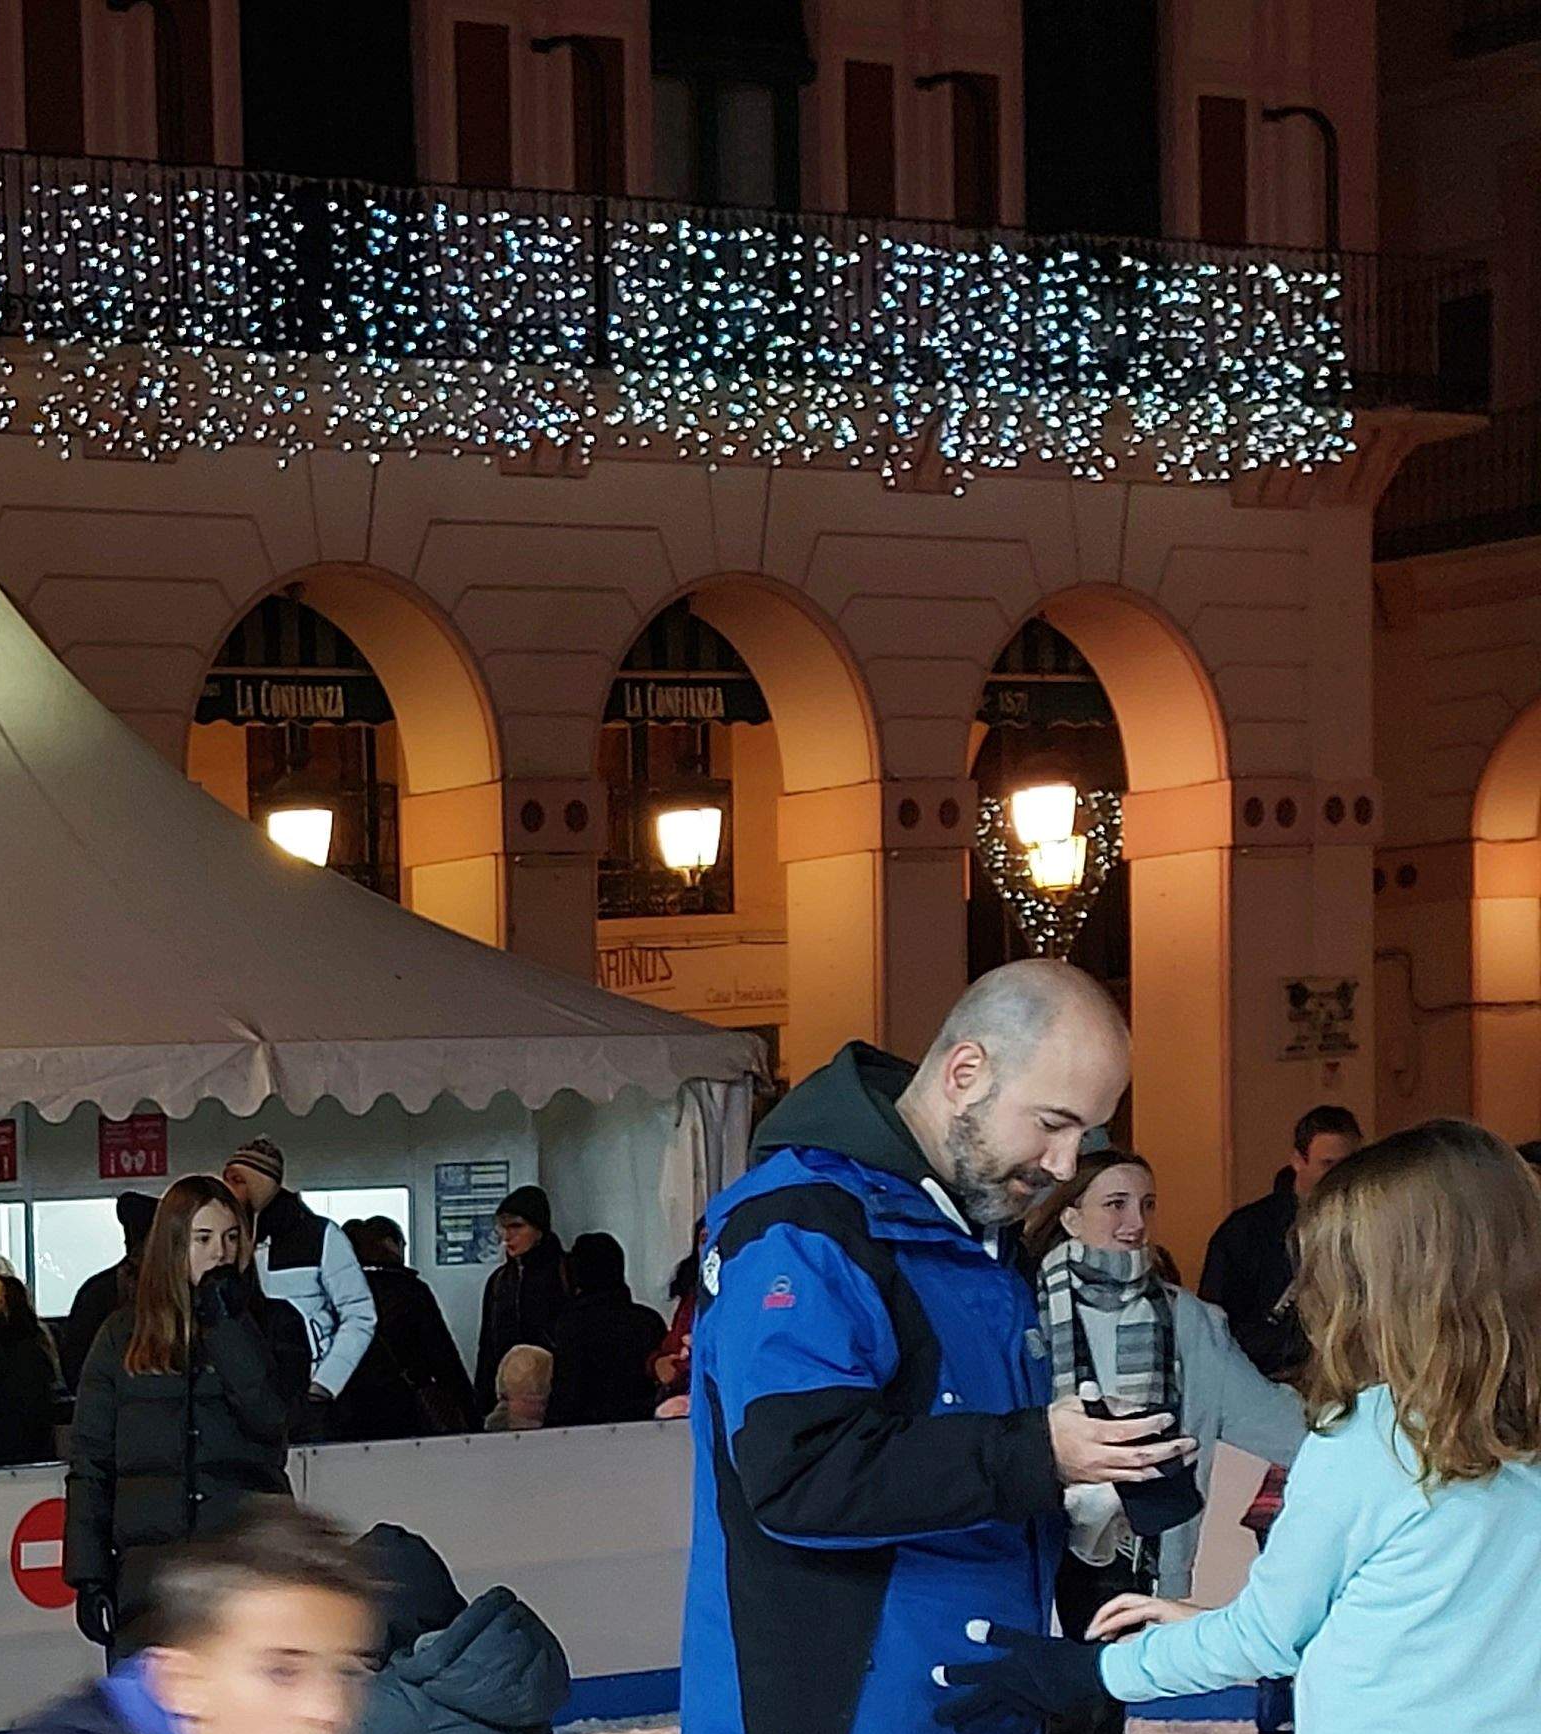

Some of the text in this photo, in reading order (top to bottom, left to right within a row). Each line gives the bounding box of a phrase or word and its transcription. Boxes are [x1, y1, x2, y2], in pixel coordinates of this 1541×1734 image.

[236, 679, 255, 717] LA
[261, 680, 345, 719] CONFIANZA
[624, 682, 725, 718] LA CONFIANZA
